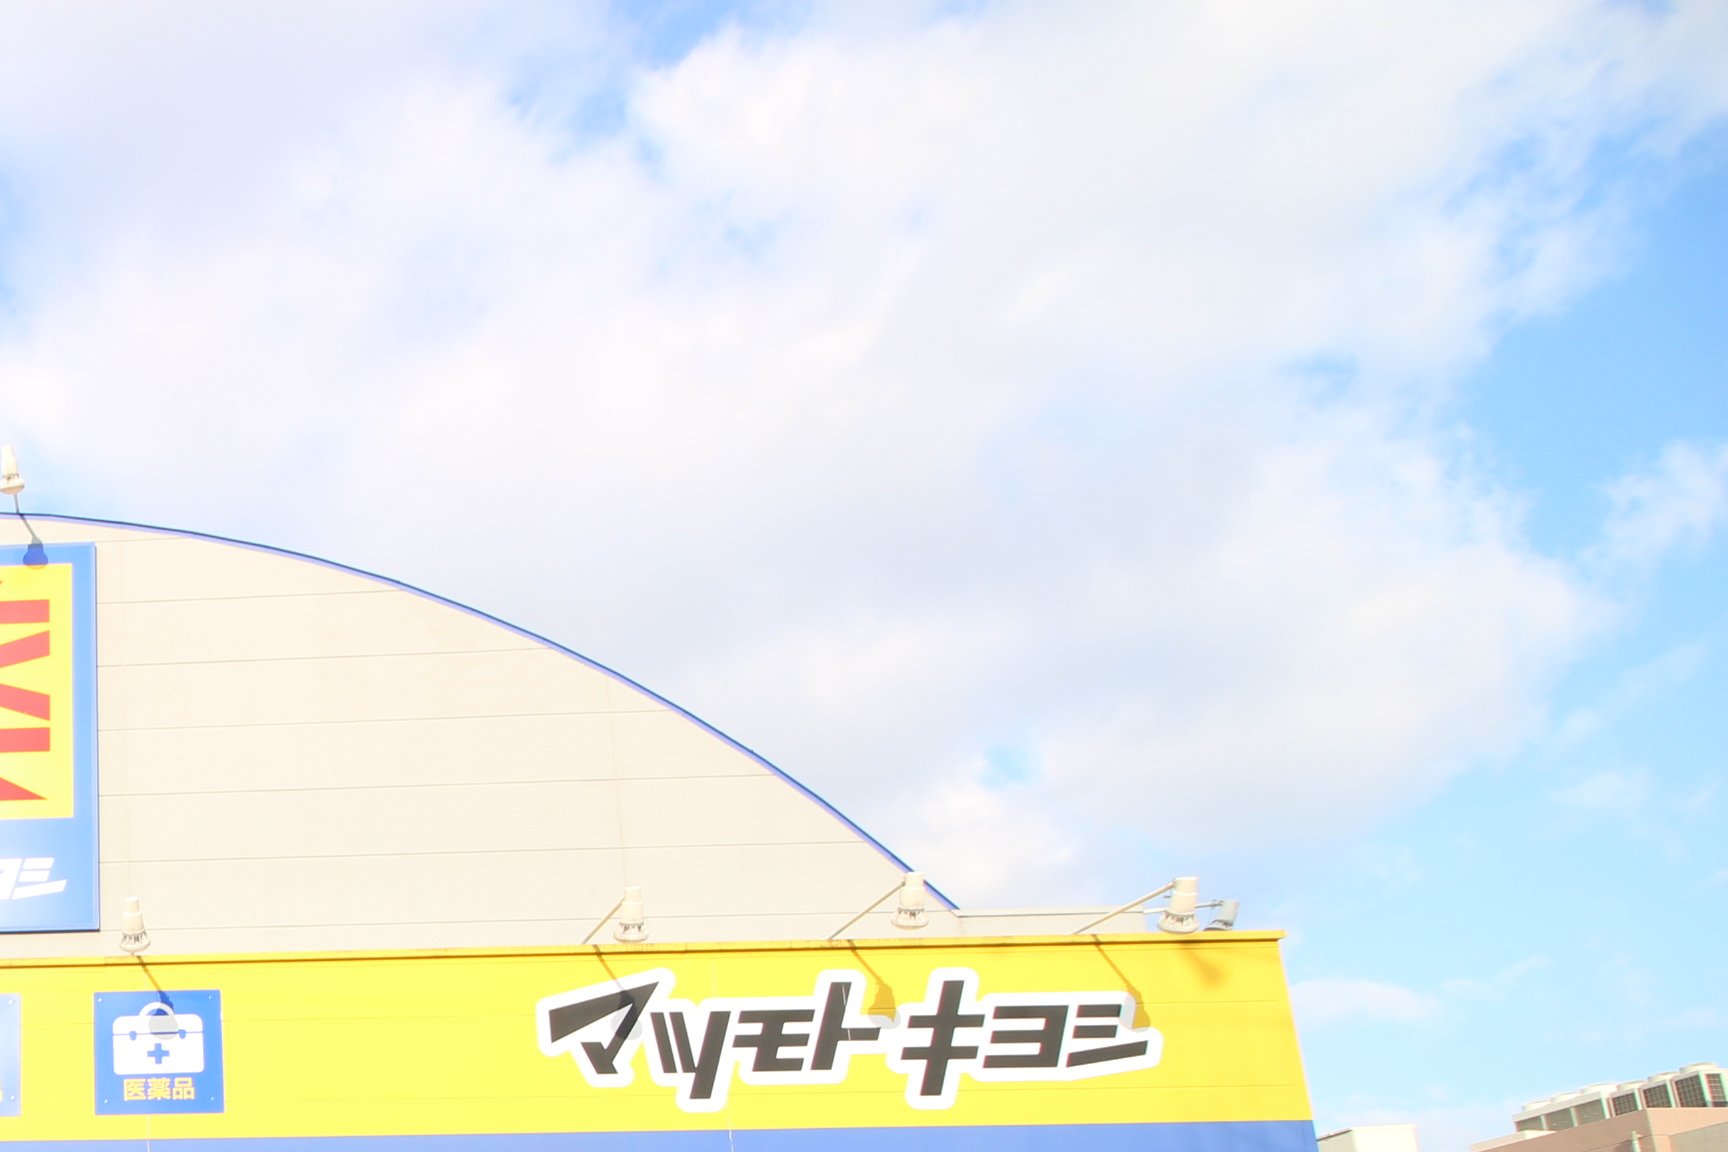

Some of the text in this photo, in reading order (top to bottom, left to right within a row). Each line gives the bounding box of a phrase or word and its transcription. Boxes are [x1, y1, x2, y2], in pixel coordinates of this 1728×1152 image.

[549, 980, 1149, 1100] マツモトキヨシ
[123, 1076, 196, 1102] 医薬品
